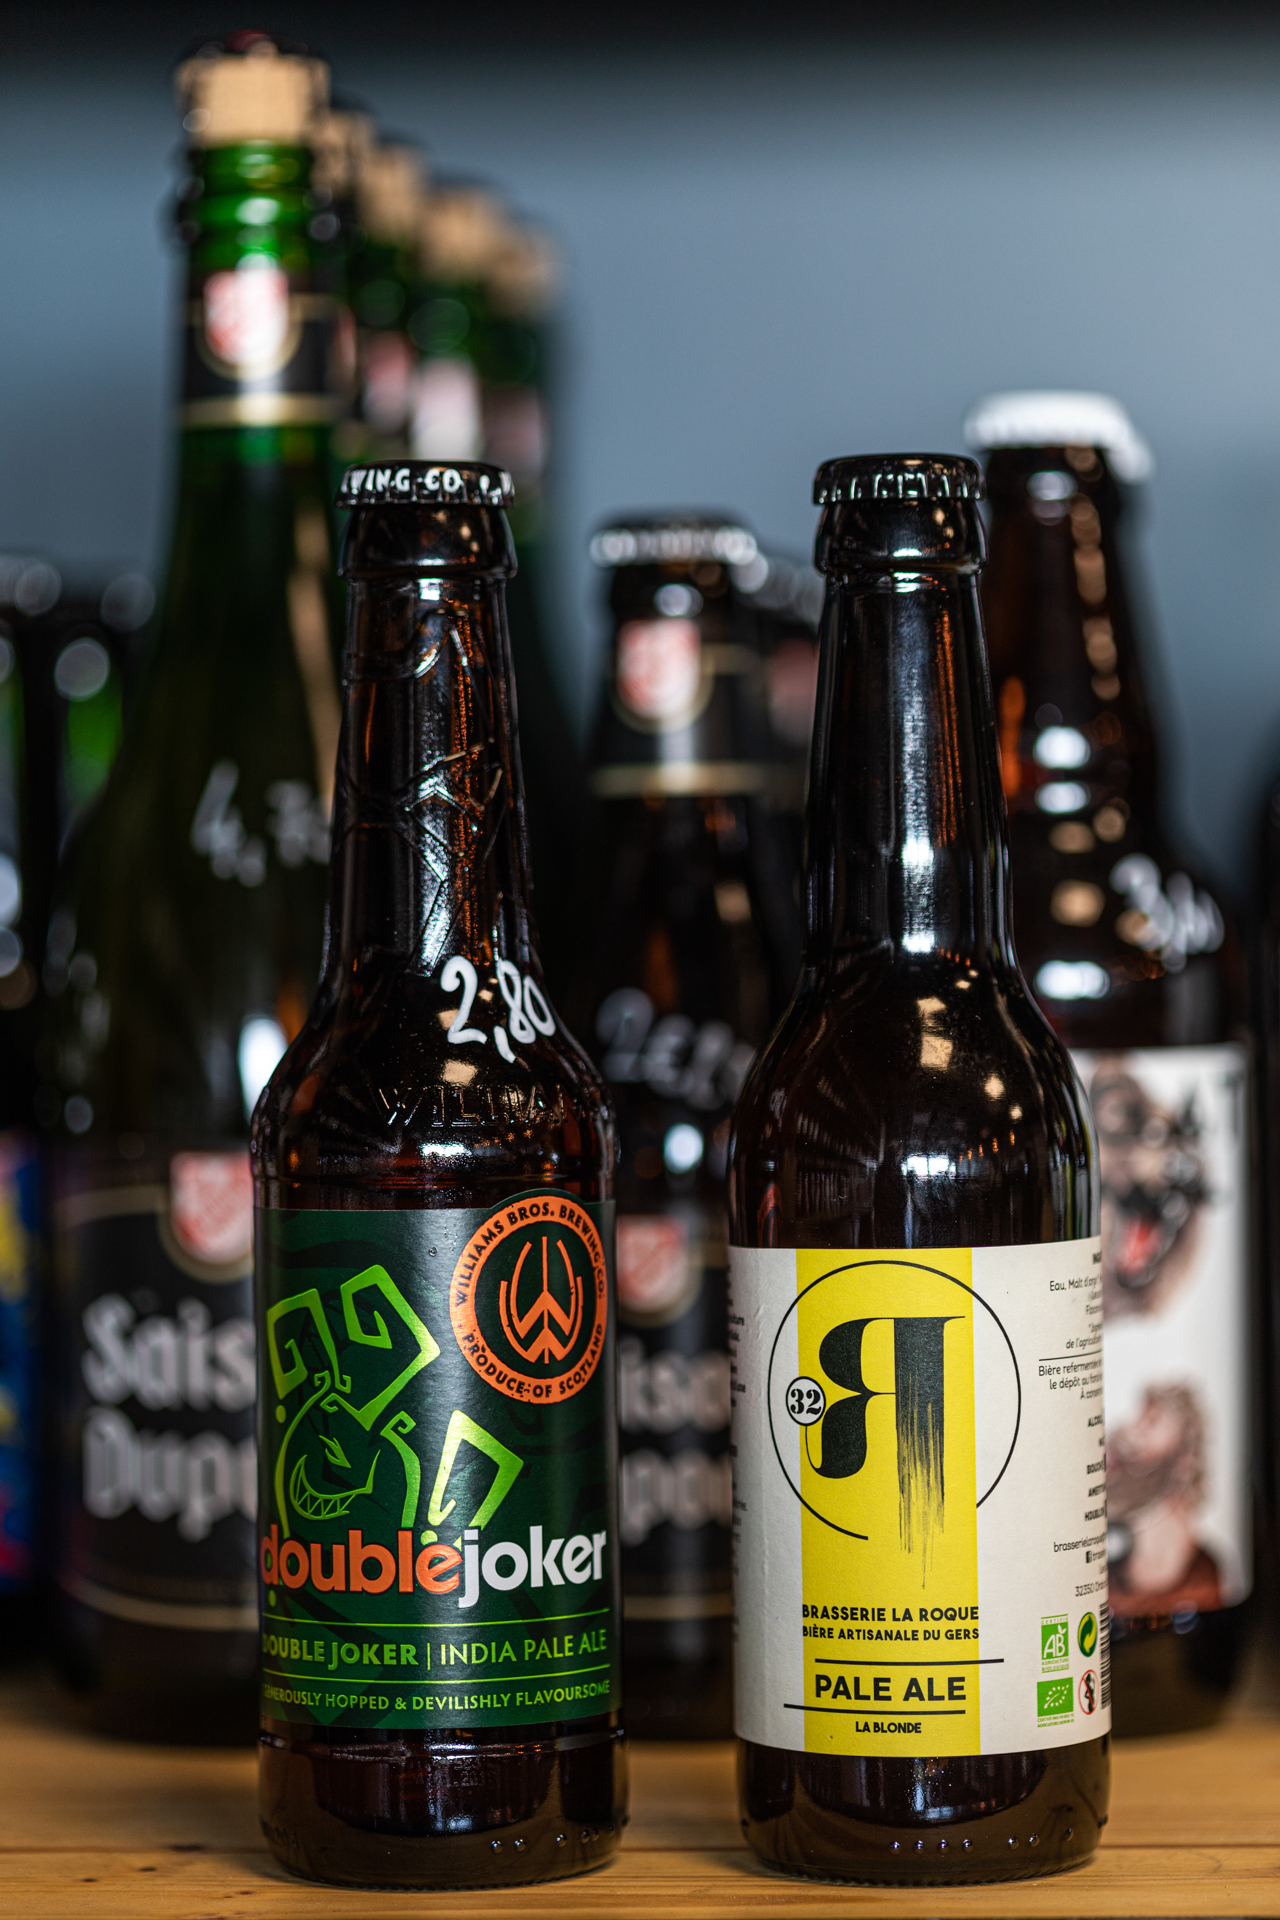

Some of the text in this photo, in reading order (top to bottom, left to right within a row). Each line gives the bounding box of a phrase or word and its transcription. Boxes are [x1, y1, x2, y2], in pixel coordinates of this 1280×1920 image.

[455, 1220, 505, 1307] WILLIAMS
[507, 1202, 555, 1226] BROS.
[559, 1205, 601, 1263] BREWING
[462, 1332, 526, 1394] PRODUCE
[532, 1384, 552, 1398] OF
[559, 1324, 603, 1394] SCOTLAND
[1038, 1364, 1061, 1376] Bière
[1049, 1379, 1058, 1390] le
[1059, 1375, 1081, 1391] dépôt
[790, 1389, 822, 1415] 32
[802, 1604, 979, 1622] BRASSERIE LA ROQUE
[802, 1624, 979, 1641] BIÈRE ARTISANALE DU GERS
[327, 1641, 419, 1671] JOKER
[440, 1641, 516, 1666] INDIA
[524, 1635, 574, 1660] PALE
[579, 1629, 607, 1654] ALE
[1043, 1633, 1065, 1658] AB
[326, 1693, 389, 1710] HOPPED
[395, 1697, 407, 1710] &
[412, 1693, 511, 1711] DEVILISHLY
[516, 1680, 610, 1706] FLAVOURSOME
[815, 1674, 966, 1702] PALE ALE
[855, 1721, 922, 1733] LA BLONDE
